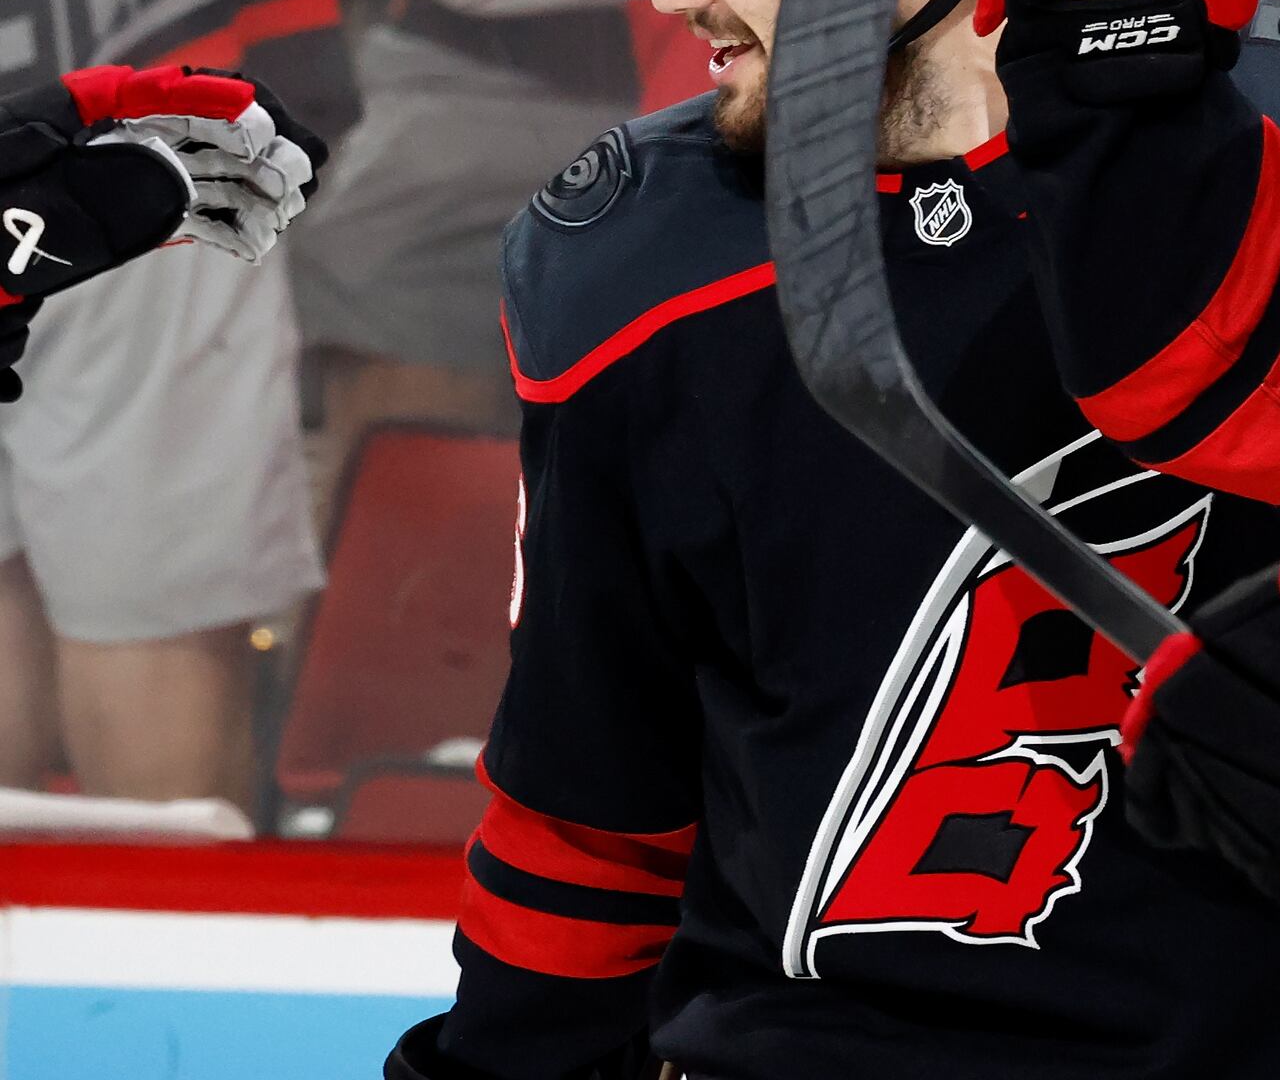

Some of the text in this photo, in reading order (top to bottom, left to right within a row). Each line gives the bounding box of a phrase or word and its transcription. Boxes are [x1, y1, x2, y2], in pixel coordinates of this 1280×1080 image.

[1109, 16, 1146, 31] PRO
[1078, 25, 1181, 55] CCM
[928, 196, 958, 235] NHL
